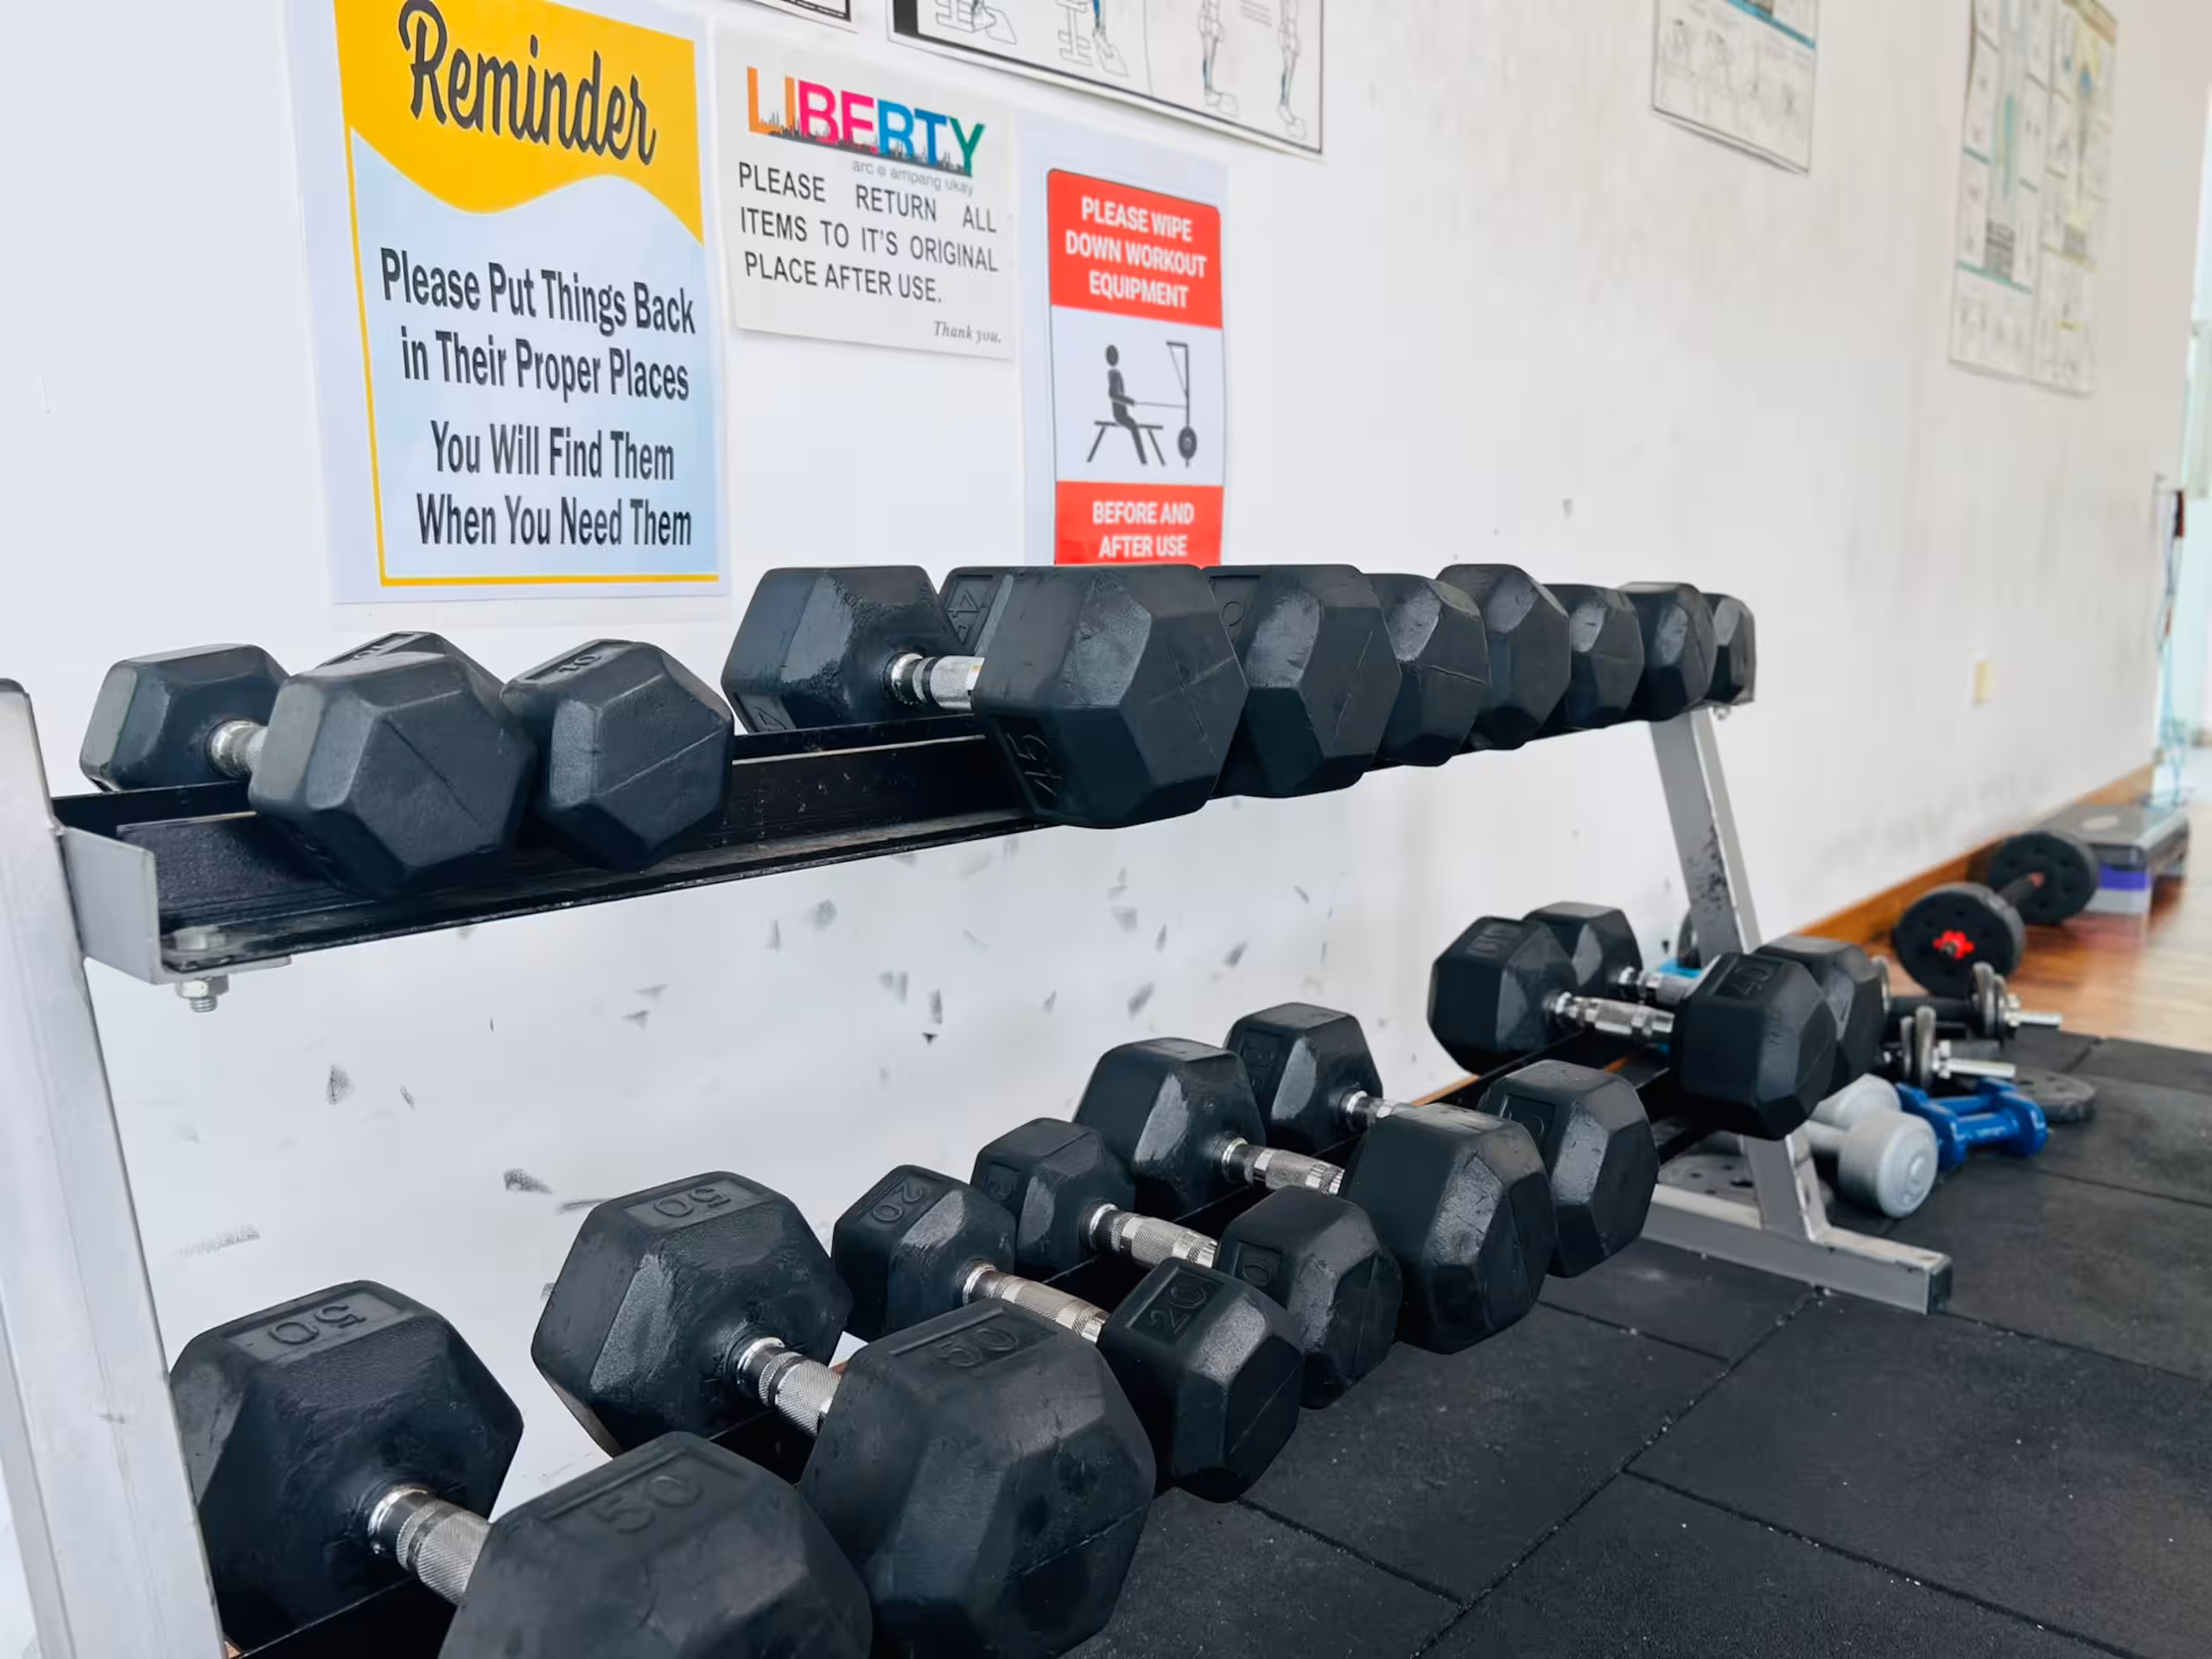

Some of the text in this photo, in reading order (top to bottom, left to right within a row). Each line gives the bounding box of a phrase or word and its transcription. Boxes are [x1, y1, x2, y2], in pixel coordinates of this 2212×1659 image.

[398, 0, 656, 165] Reminder
[747, 66, 986, 177] LIBERTY
[739, 162, 997, 233] PLEASE RETURN ALL
[1081, 195, 1193, 243] PLEASE WIPE
[741, 207, 999, 272] ITEMS TO IT'S ORIGINAL
[1065, 229, 1207, 279] DOWN WORKOUT
[380, 247, 696, 336] Please Put Things Back
[745, 251, 942, 303] PLACE AFTER USE.
[1089, 269, 1189, 308] EQUIPMENT
[934, 320, 1001, 346] Thank you.
[401, 326, 690, 403] in Their Proper Places
[430, 420, 674, 480] You Will Find Them
[416, 493, 691, 545] When You Need Them
[1092, 500, 1195, 525] BEFORE AND
[1098, 534, 1188, 559] AFTER USE
[652, 1186, 732, 1219] 50
[870, 1175, 925, 1224] 20
[268, 1304, 367, 1346] 50
[1147, 1283, 1207, 1336] 20
[938, 1326, 1020, 1368] 50
[589, 1472, 705, 1535] 50
